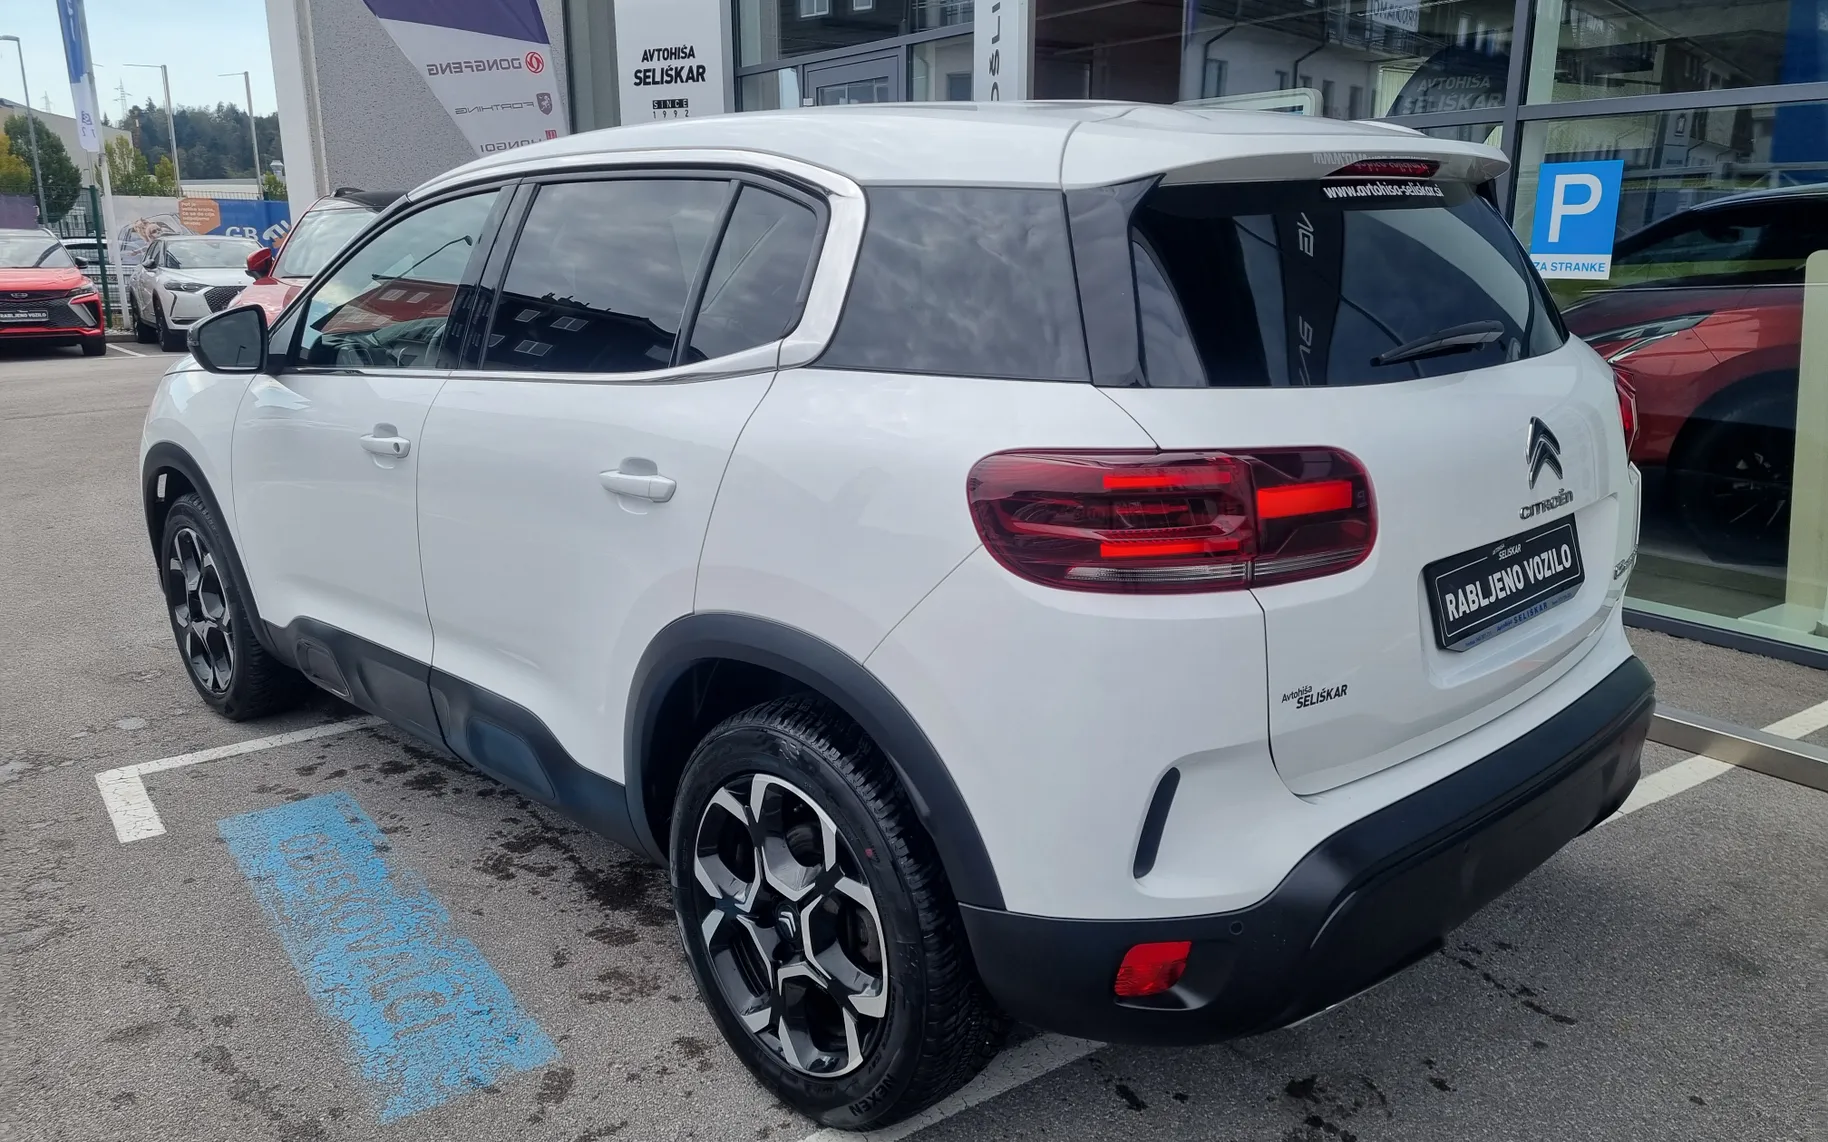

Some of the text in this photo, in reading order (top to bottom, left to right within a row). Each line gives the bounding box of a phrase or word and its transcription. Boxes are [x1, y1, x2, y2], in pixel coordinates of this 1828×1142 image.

[653, 98, 689, 109] SINCE
[1548, 173, 1603, 243] P
[1550, 261, 1607, 273] STRANKE
[1445, 564, 1525, 622] RABLJENO
[1523, 543, 1573, 584] VOZILO
[848, 1072, 897, 1117] NEXEN
